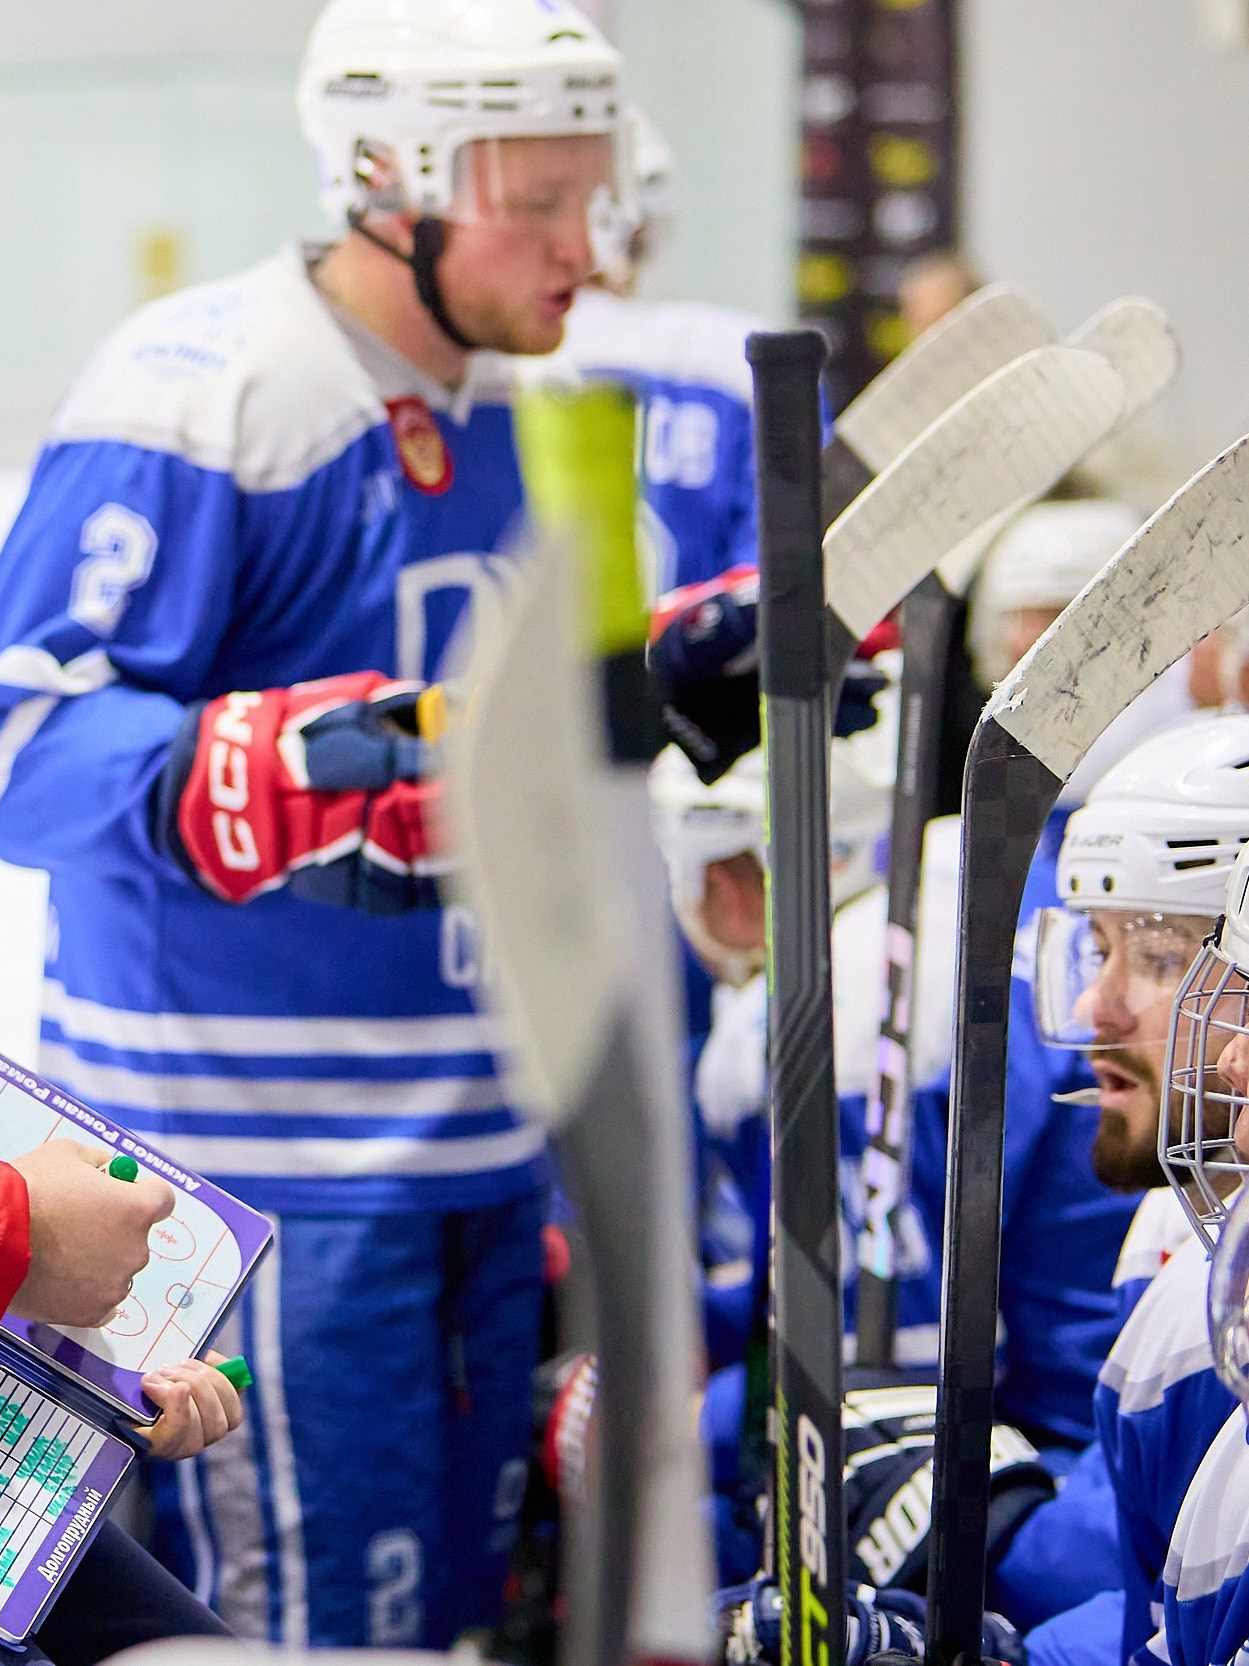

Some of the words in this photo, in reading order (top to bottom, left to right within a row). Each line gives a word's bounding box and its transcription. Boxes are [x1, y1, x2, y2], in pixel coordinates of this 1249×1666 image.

[67, 502, 158, 641] 2
[209, 691, 264, 871] CCM
[51, 1093, 119, 1143] Роман
[121, 1137, 202, 1193] Акимов
[36, 1486, 103, 1584] Долгопрудный
